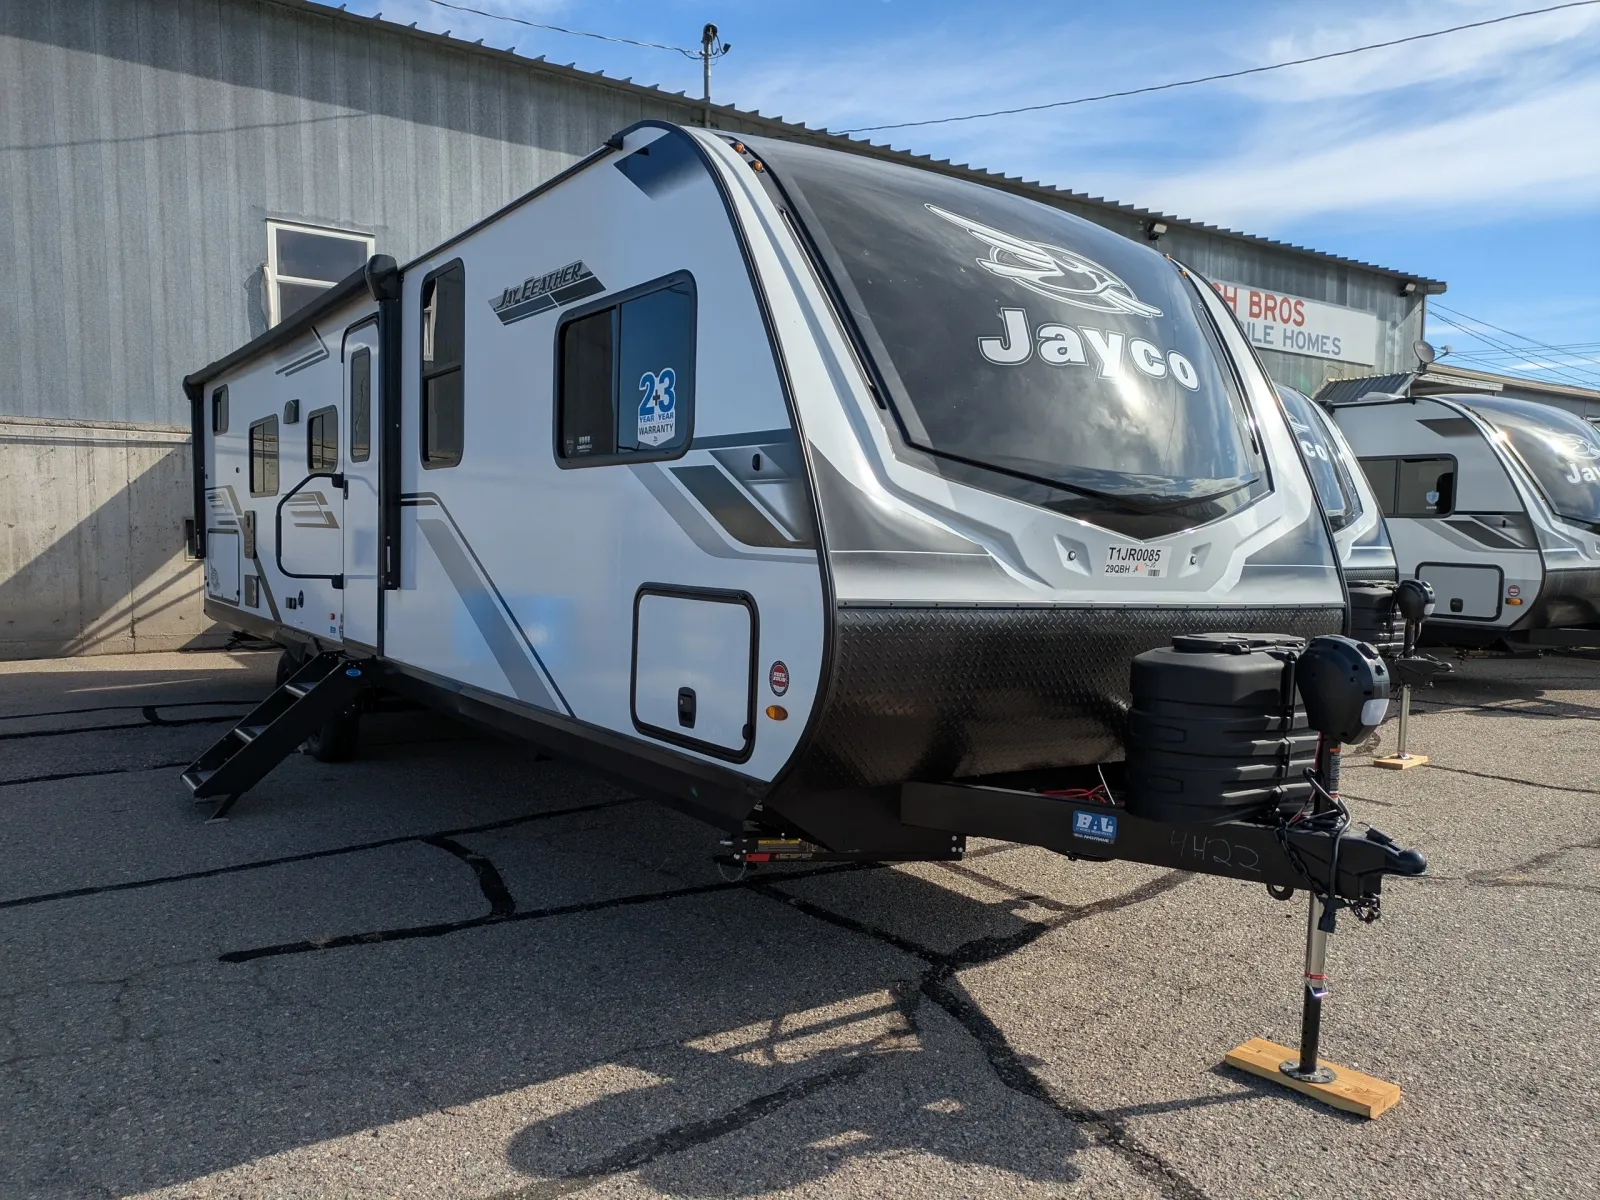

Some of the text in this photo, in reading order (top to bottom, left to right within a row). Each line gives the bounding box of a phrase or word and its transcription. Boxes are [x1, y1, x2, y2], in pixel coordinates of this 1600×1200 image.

[495, 260, 583, 310] JAY FEATHER
[1249, 290, 1305, 327] BROS
[978, 308, 1200, 391] Jayco
[1283, 328, 1342, 356] HOMES
[639, 423, 674, 435] WARRANTY
[640, 415, 654, 424] YEAR
[658, 411, 674, 420] YEAR
[1109, 547, 1161, 562] T1JR0085
[1105, 564, 1130, 574] 29QBH
[1076, 813, 1114, 833] BAL
[1170, 829, 1261, 872] 4422
